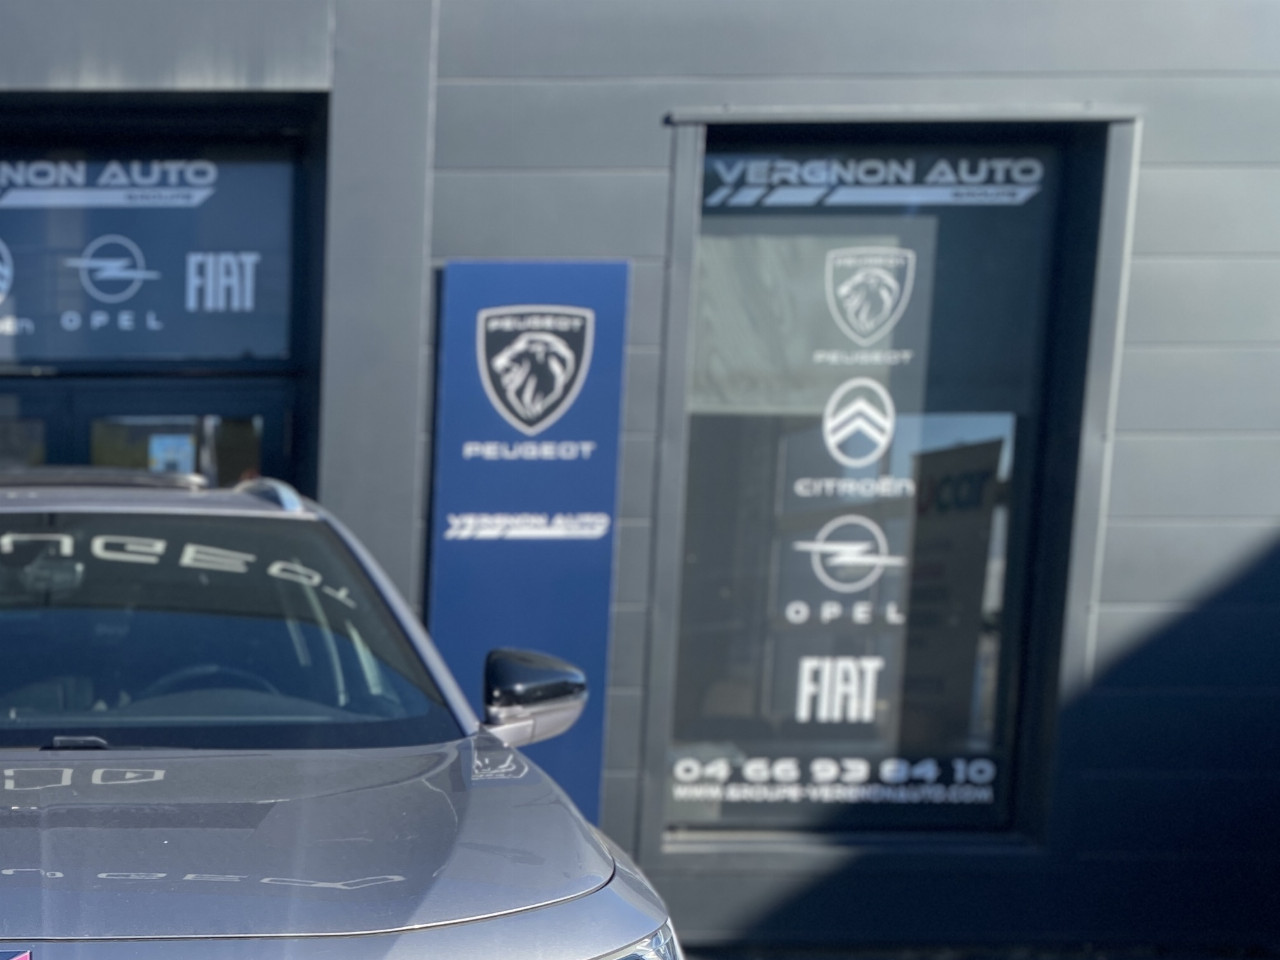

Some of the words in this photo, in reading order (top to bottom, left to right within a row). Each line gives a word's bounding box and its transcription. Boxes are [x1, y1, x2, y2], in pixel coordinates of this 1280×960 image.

[96, 160, 219, 187] AUTO
[713, 158, 916, 185] VERGNON
[923, 157, 1045, 184] AUTO
[185, 251, 261, 313] FIAT
[60, 311, 164, 331] OPEL
[486, 315, 585, 332] PEUGEOT
[812, 349, 913, 366] PEUGEOT
[462, 441, 596, 460] PEUGEOT
[785, 600, 906, 625] OPEL
[795, 656, 885, 724] FIAT
[673, 757, 731, 783] 04
[742, 757, 801, 783] 66
[809, 757, 870, 783] 93
[951, 757, 997, 783] 10
